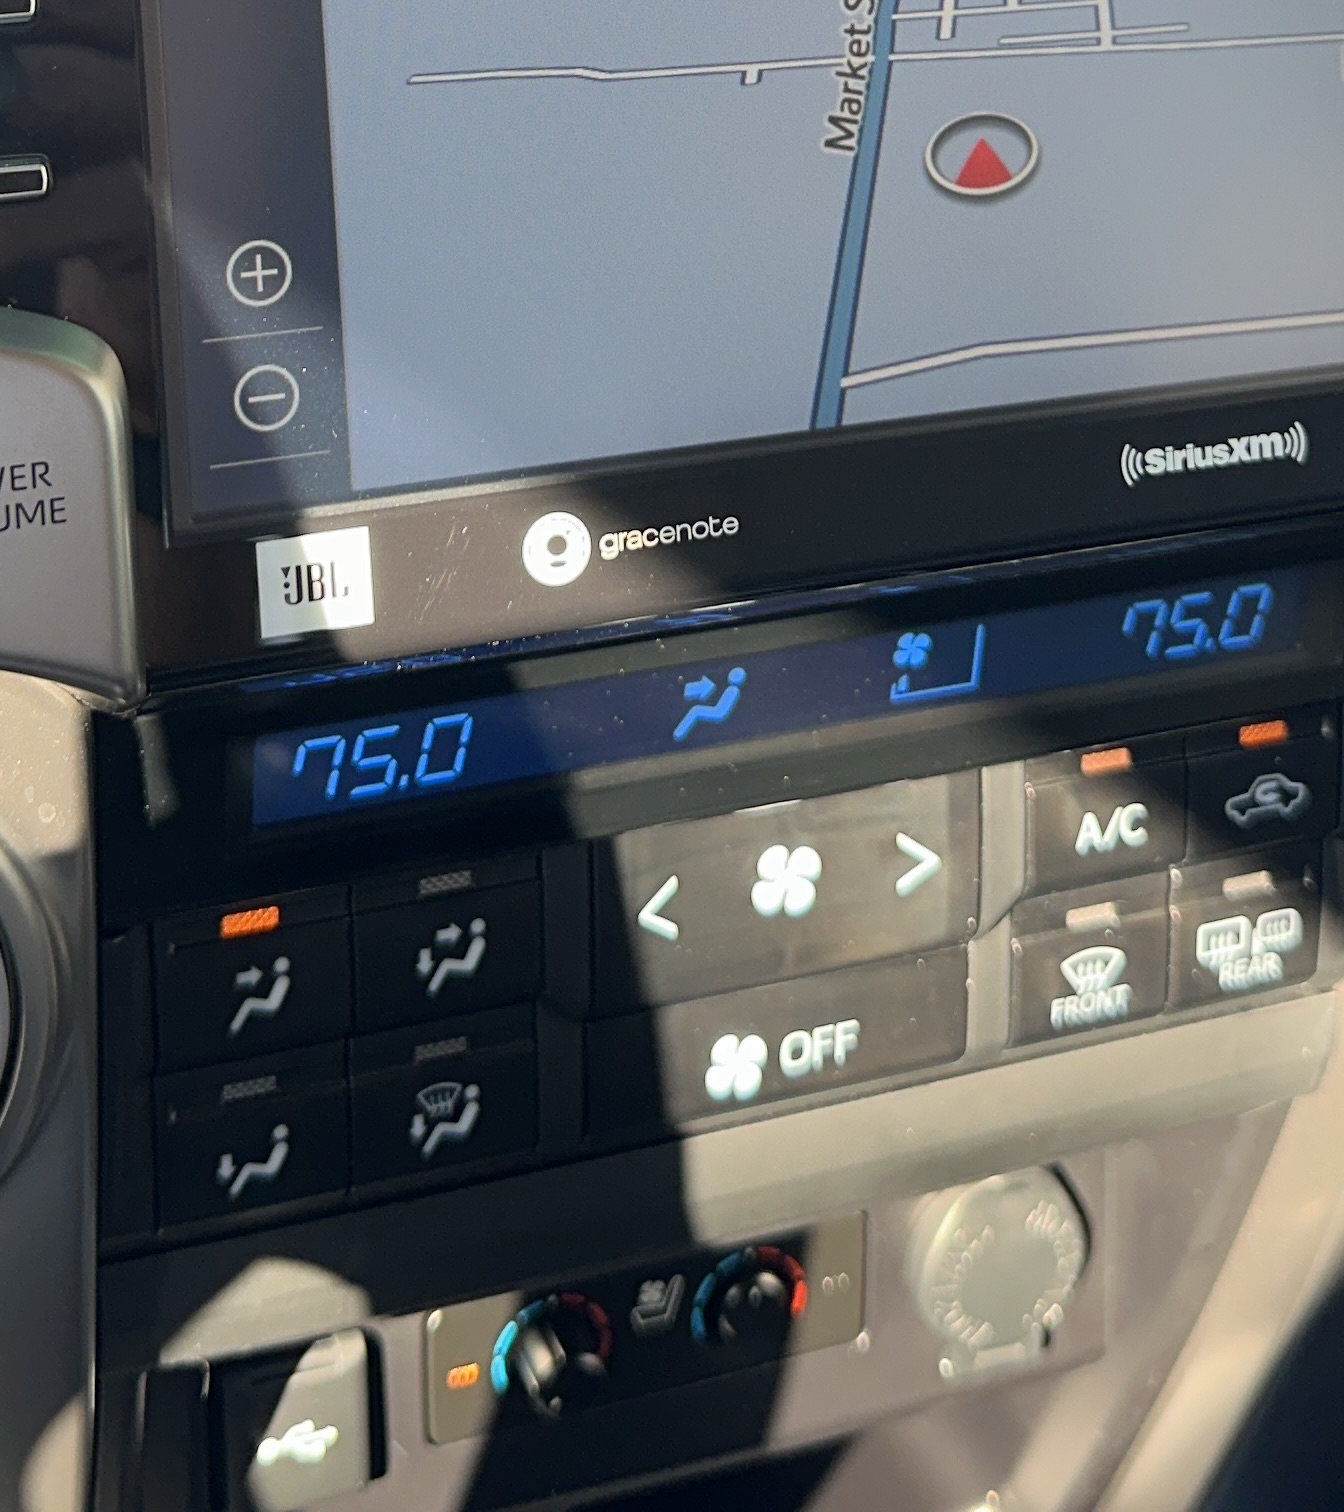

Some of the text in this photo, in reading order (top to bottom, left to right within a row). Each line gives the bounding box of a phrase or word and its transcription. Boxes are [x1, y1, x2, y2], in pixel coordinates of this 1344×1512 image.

[824, 22, 872, 152] Market
[599, 514, 740, 560] gracenote
[1122, 582, 1273, 661] 75.0
[292, 712, 473, 800] 75.0
[1074, 802, 1148, 857] A/C
[1218, 952, 1284, 992] REAR
[1050, 982, 1133, 1029] FRONT
[778, 1018, 861, 1079] OFF
